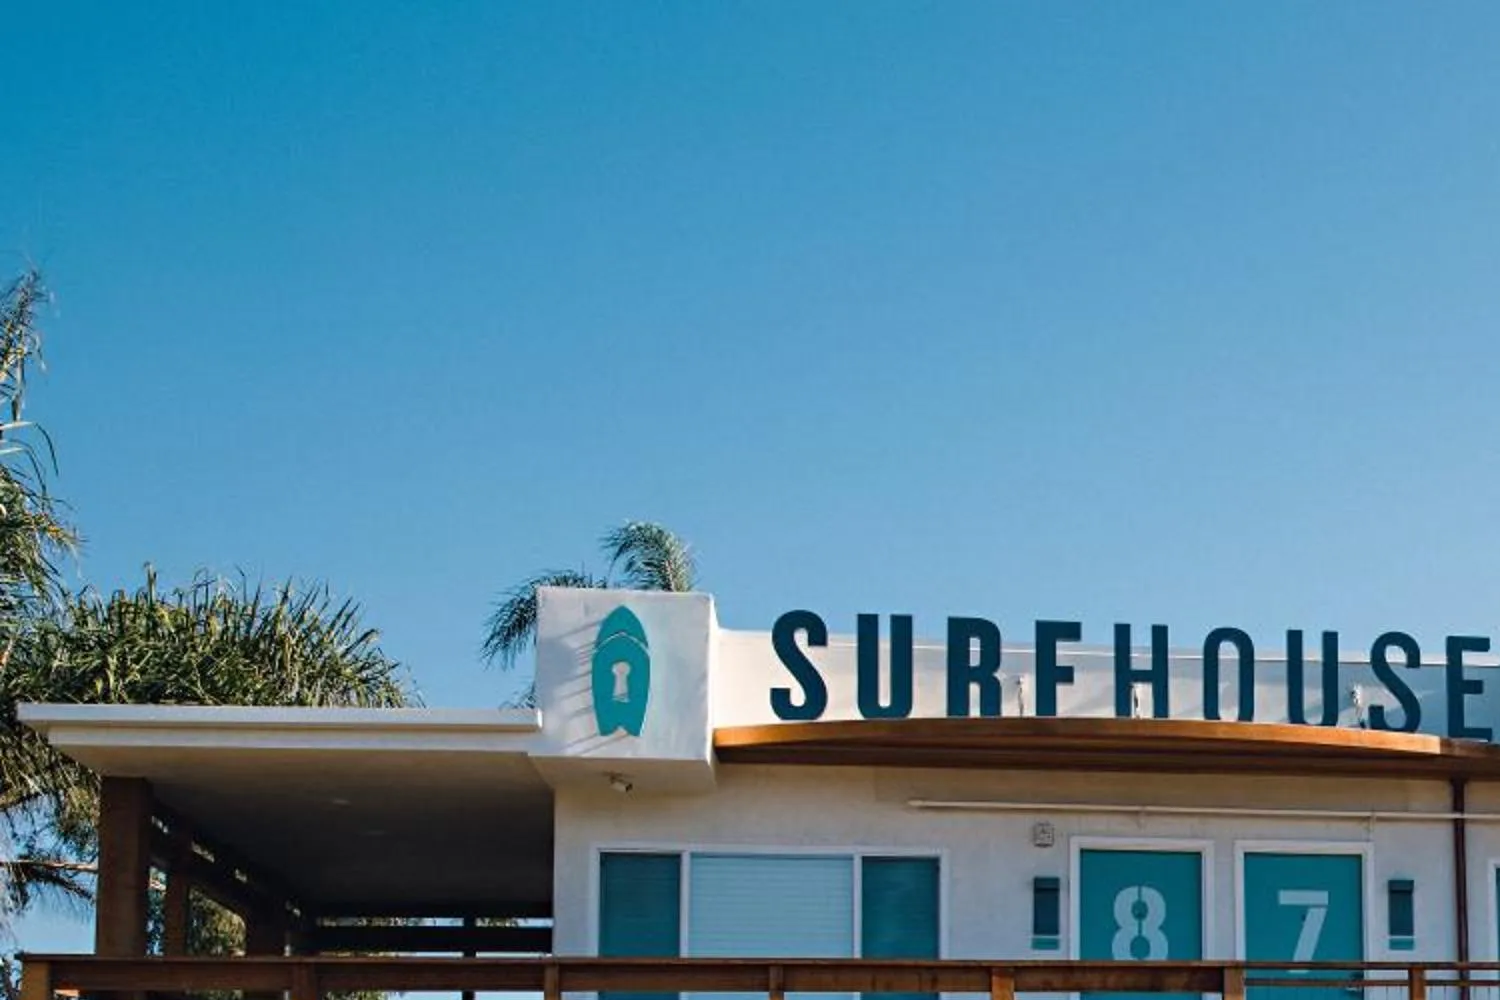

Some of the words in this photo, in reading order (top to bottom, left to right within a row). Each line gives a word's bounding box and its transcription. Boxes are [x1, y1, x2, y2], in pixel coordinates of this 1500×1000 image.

[769, 609, 1493, 742] SURFHOUSE
[1112, 885, 1169, 961] 8
[1278, 890, 1329, 973] 7
